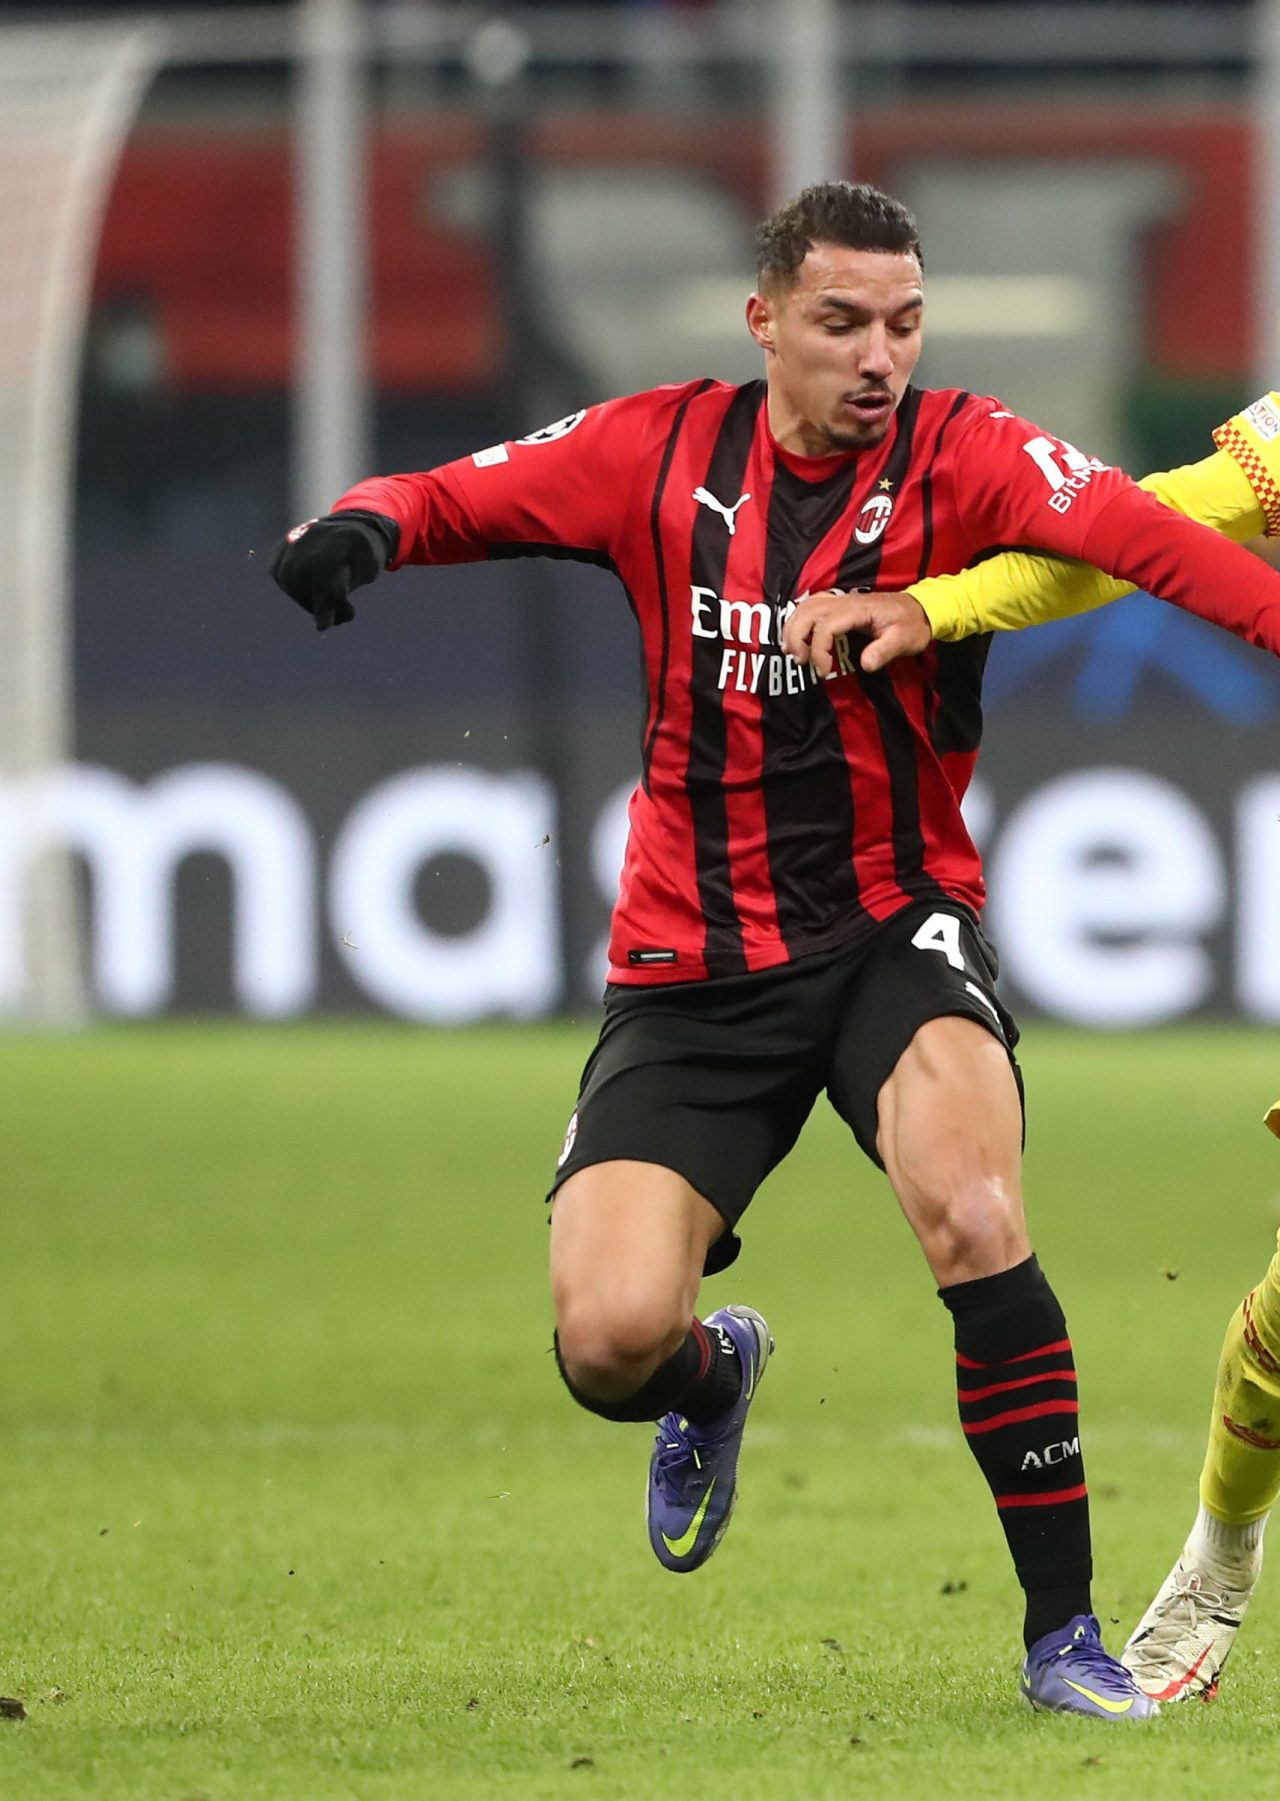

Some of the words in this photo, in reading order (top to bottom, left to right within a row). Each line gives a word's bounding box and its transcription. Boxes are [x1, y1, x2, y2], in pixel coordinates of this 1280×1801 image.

[717, 648, 765, 694] FLY
[910, 912, 965, 972] 4
[1021, 1436, 1080, 1471] ACM
